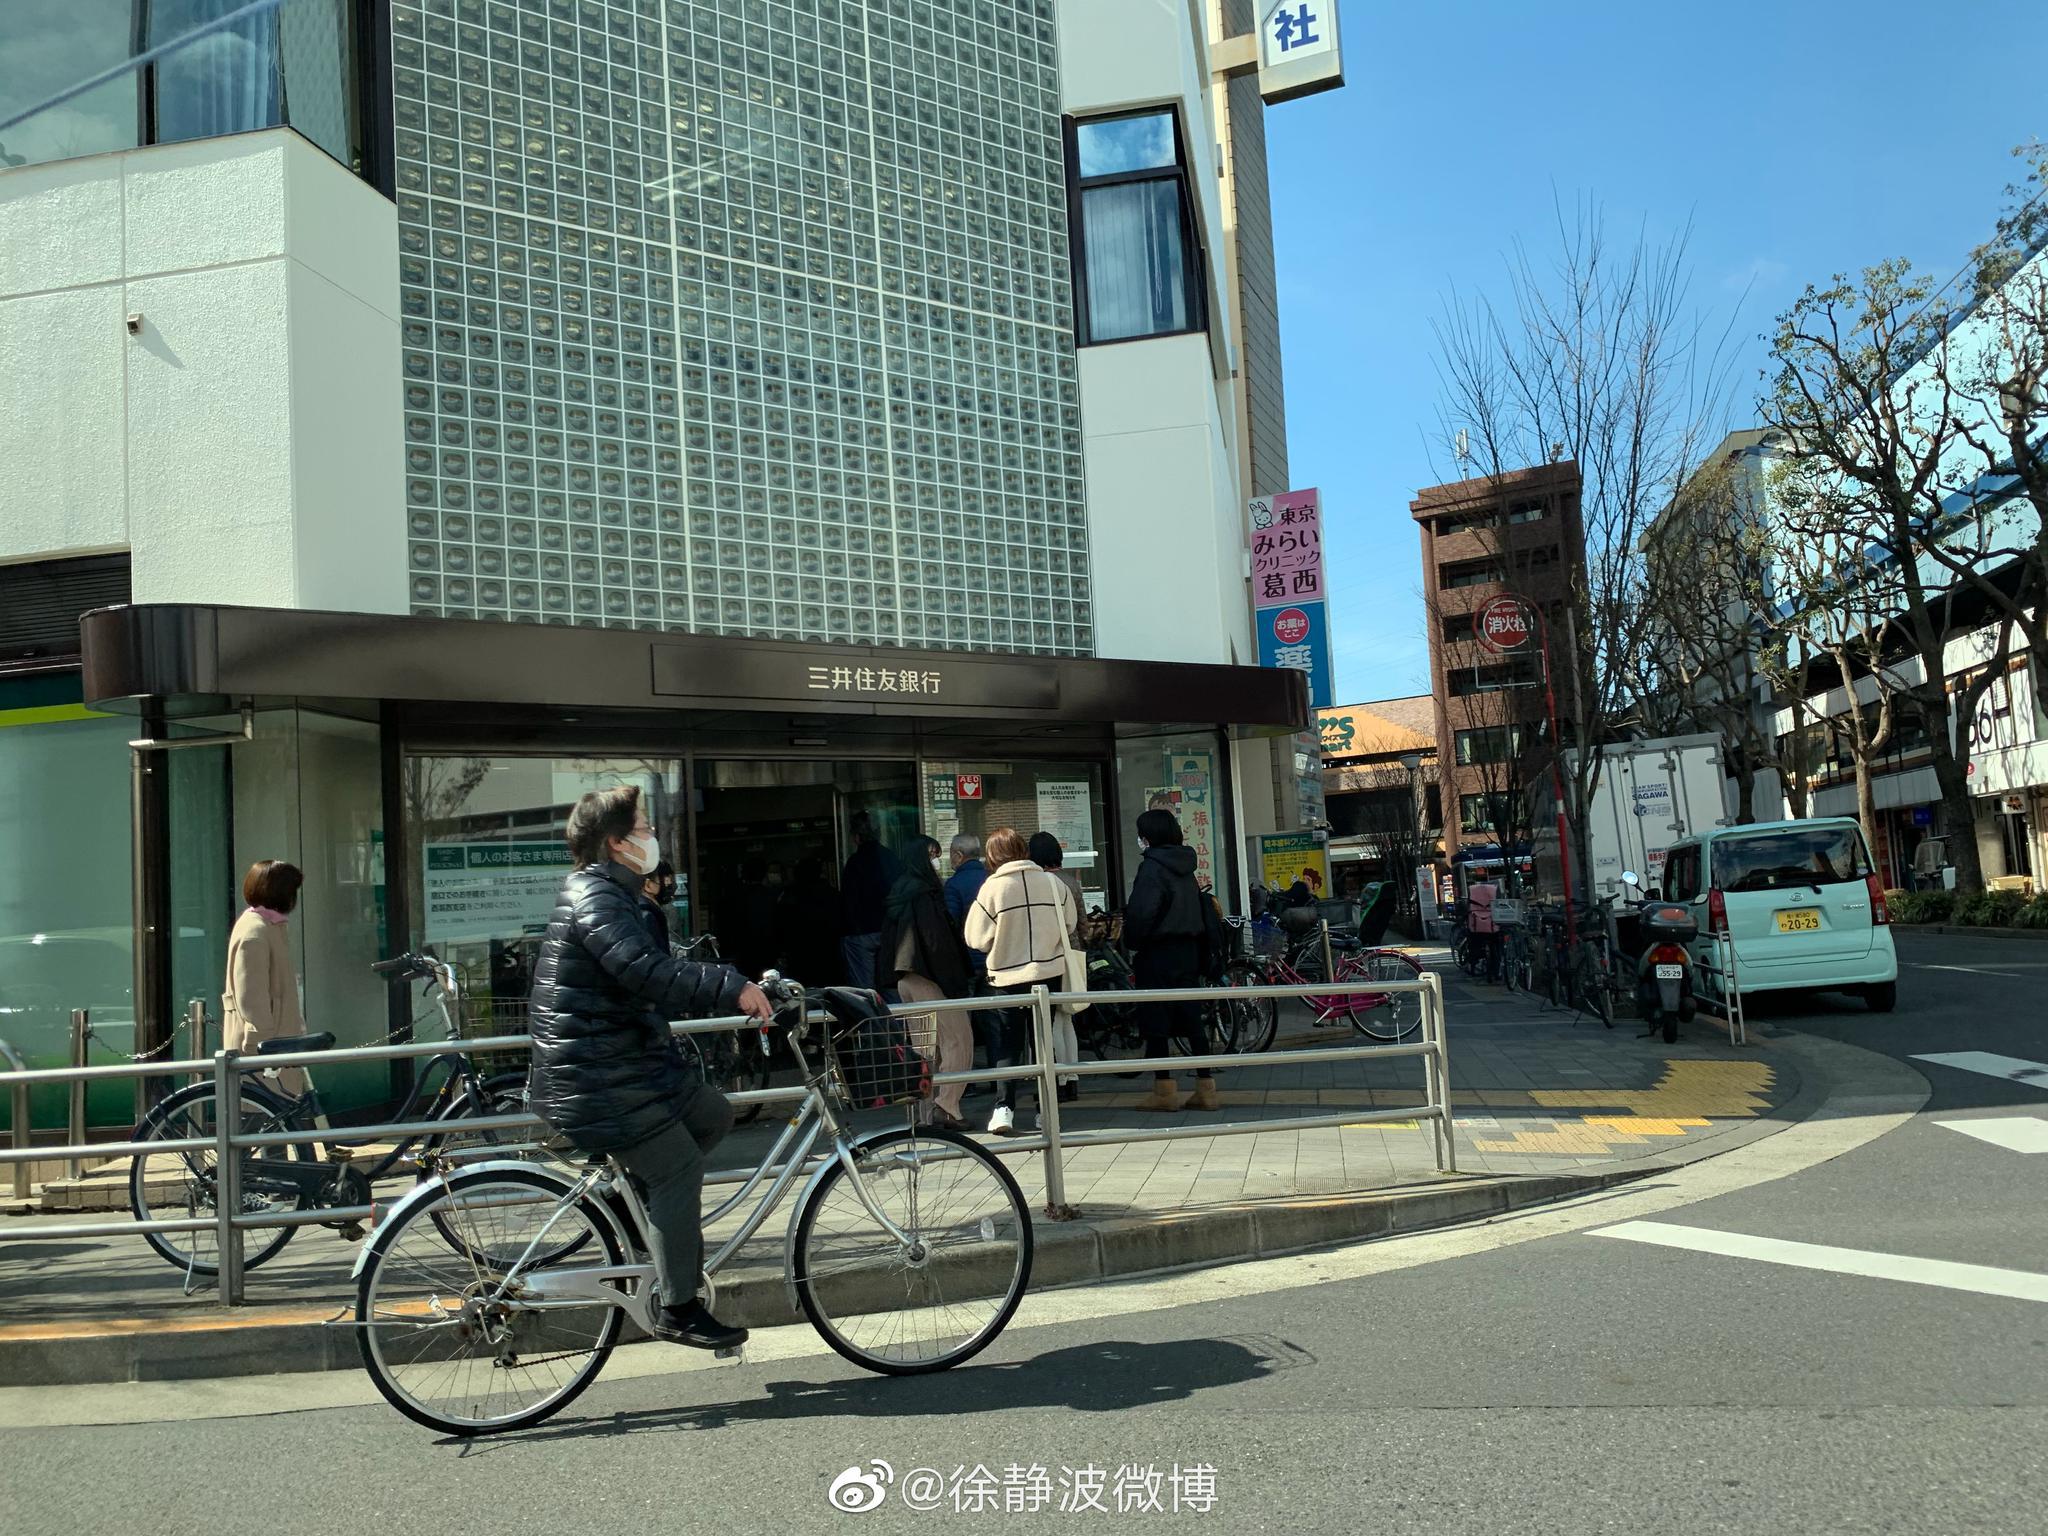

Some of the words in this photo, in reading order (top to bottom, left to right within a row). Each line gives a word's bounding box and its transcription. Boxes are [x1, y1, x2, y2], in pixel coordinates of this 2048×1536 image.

[1274, 3, 1320, 52] 社
[1279, 504, 1316, 526] 東京
[1254, 529, 1319, 556] みらい
[1255, 550, 1321, 573] クリニック
[1262, 568, 1317, 598] 葛西
[808, 666, 942, 694] 三井住友銀行
[1631, 791, 1669, 801] SAGAWA
[1787, 918, 1819, 930] 20-29
